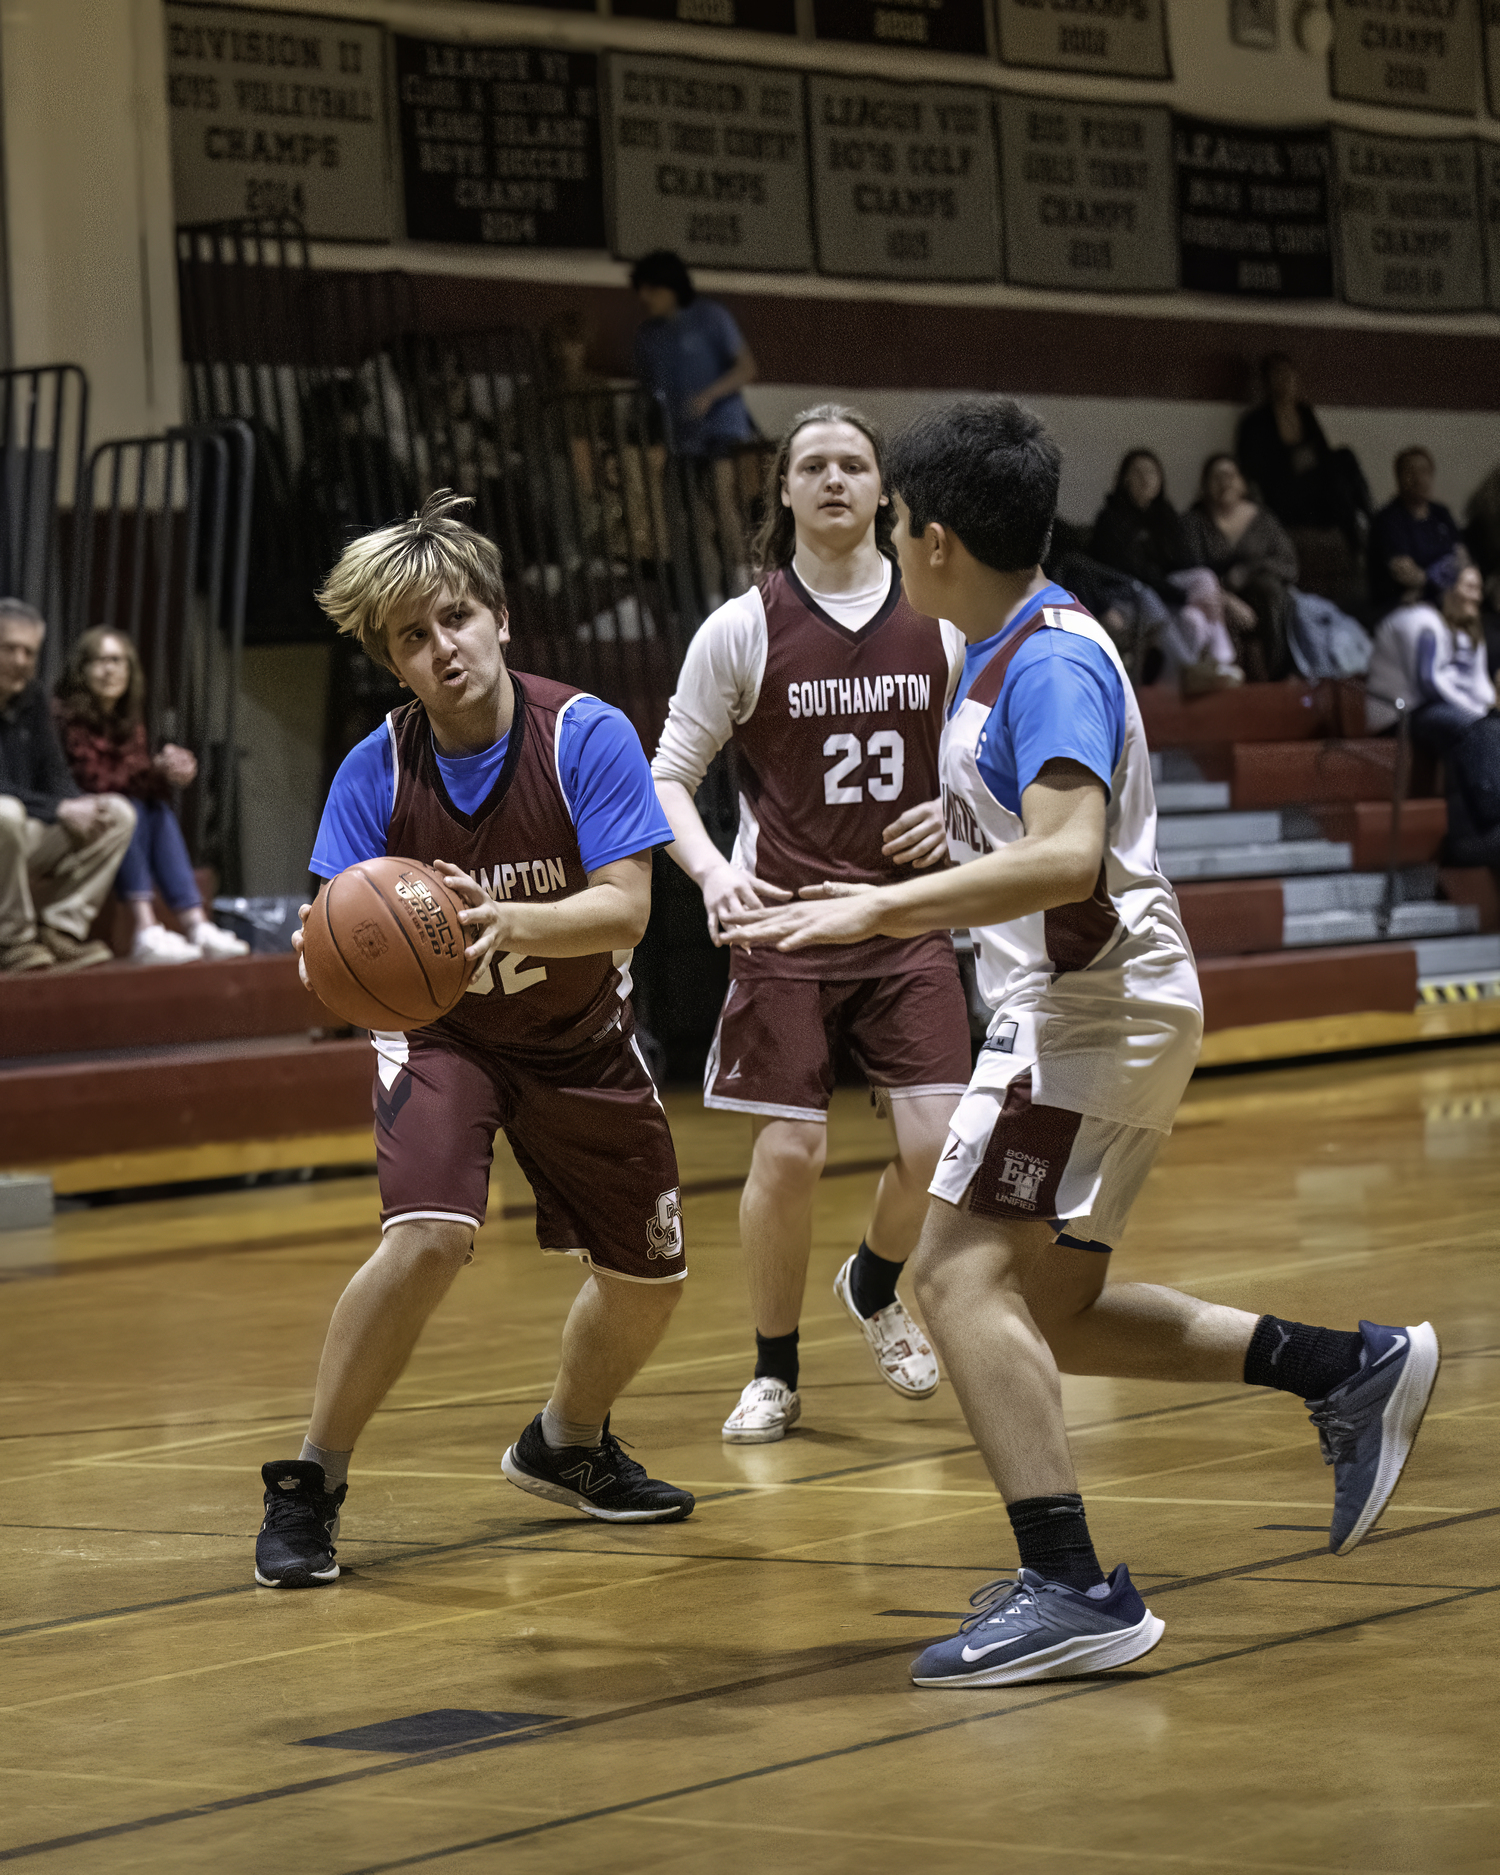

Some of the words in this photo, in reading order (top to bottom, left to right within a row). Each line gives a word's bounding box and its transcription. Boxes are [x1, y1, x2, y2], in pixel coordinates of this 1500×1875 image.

[169, 22, 322, 69] DIVISION
[204, 125, 340, 169] CHAMPS
[656, 164, 766, 206] CHAMPS
[852, 183, 958, 220] CHAMPS
[787, 674, 931, 719] SOUTHAMPTON
[823, 730, 905, 805] 23
[399, 871, 458, 959] LEGACY
[465, 950, 547, 995] 2
[1006, 1149, 1051, 1169] BONAC
[995, 1192, 1036, 1212] UNIFIED
